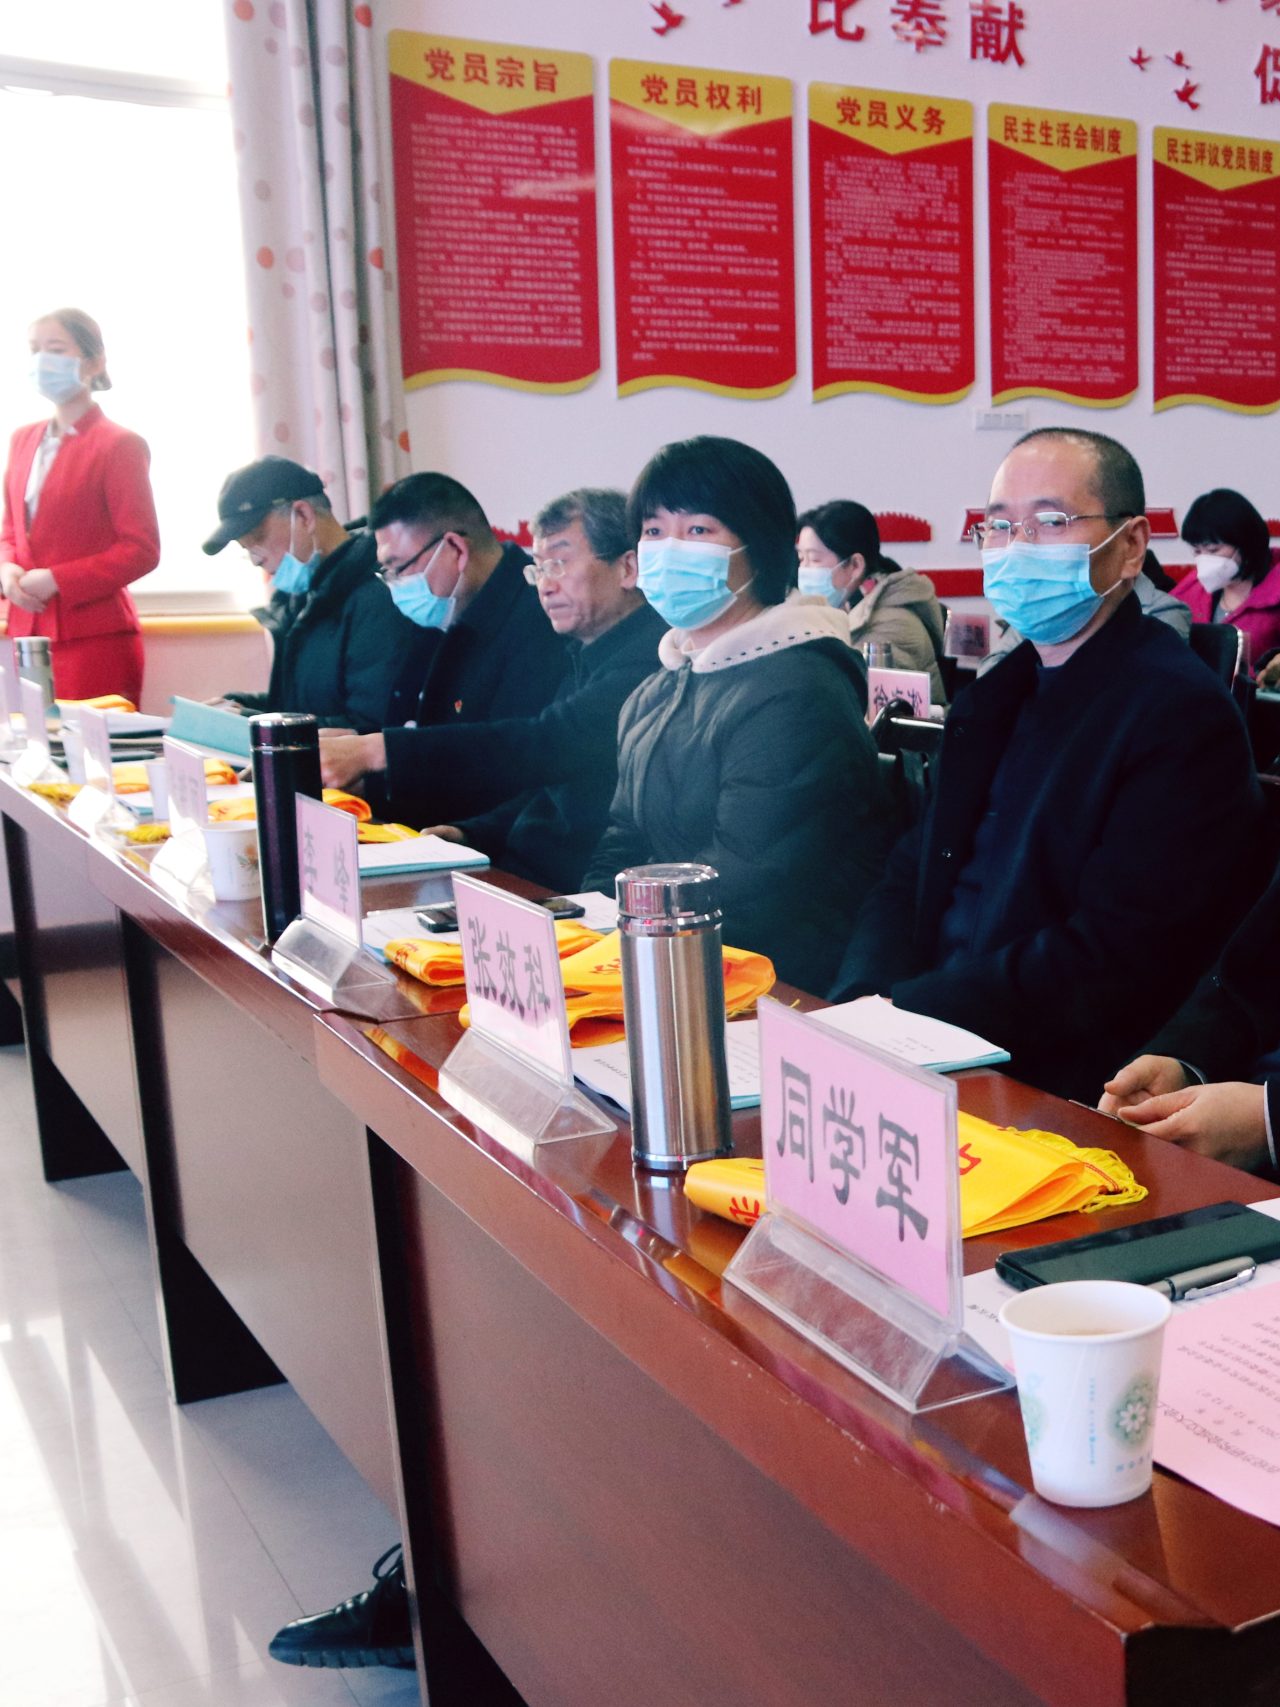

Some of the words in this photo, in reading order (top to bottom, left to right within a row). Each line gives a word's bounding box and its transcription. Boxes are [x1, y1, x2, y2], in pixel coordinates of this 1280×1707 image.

[424, 47, 560, 94] 党员宗旨
[640, 74, 763, 115] 党员权利
[836, 96, 947, 136] 党员义务
[1003, 114, 1123, 155] 民主生活会制度
[1166, 137, 1275, 175] 民主评议党员制度
[777, 1056, 929, 1242] 同学军
